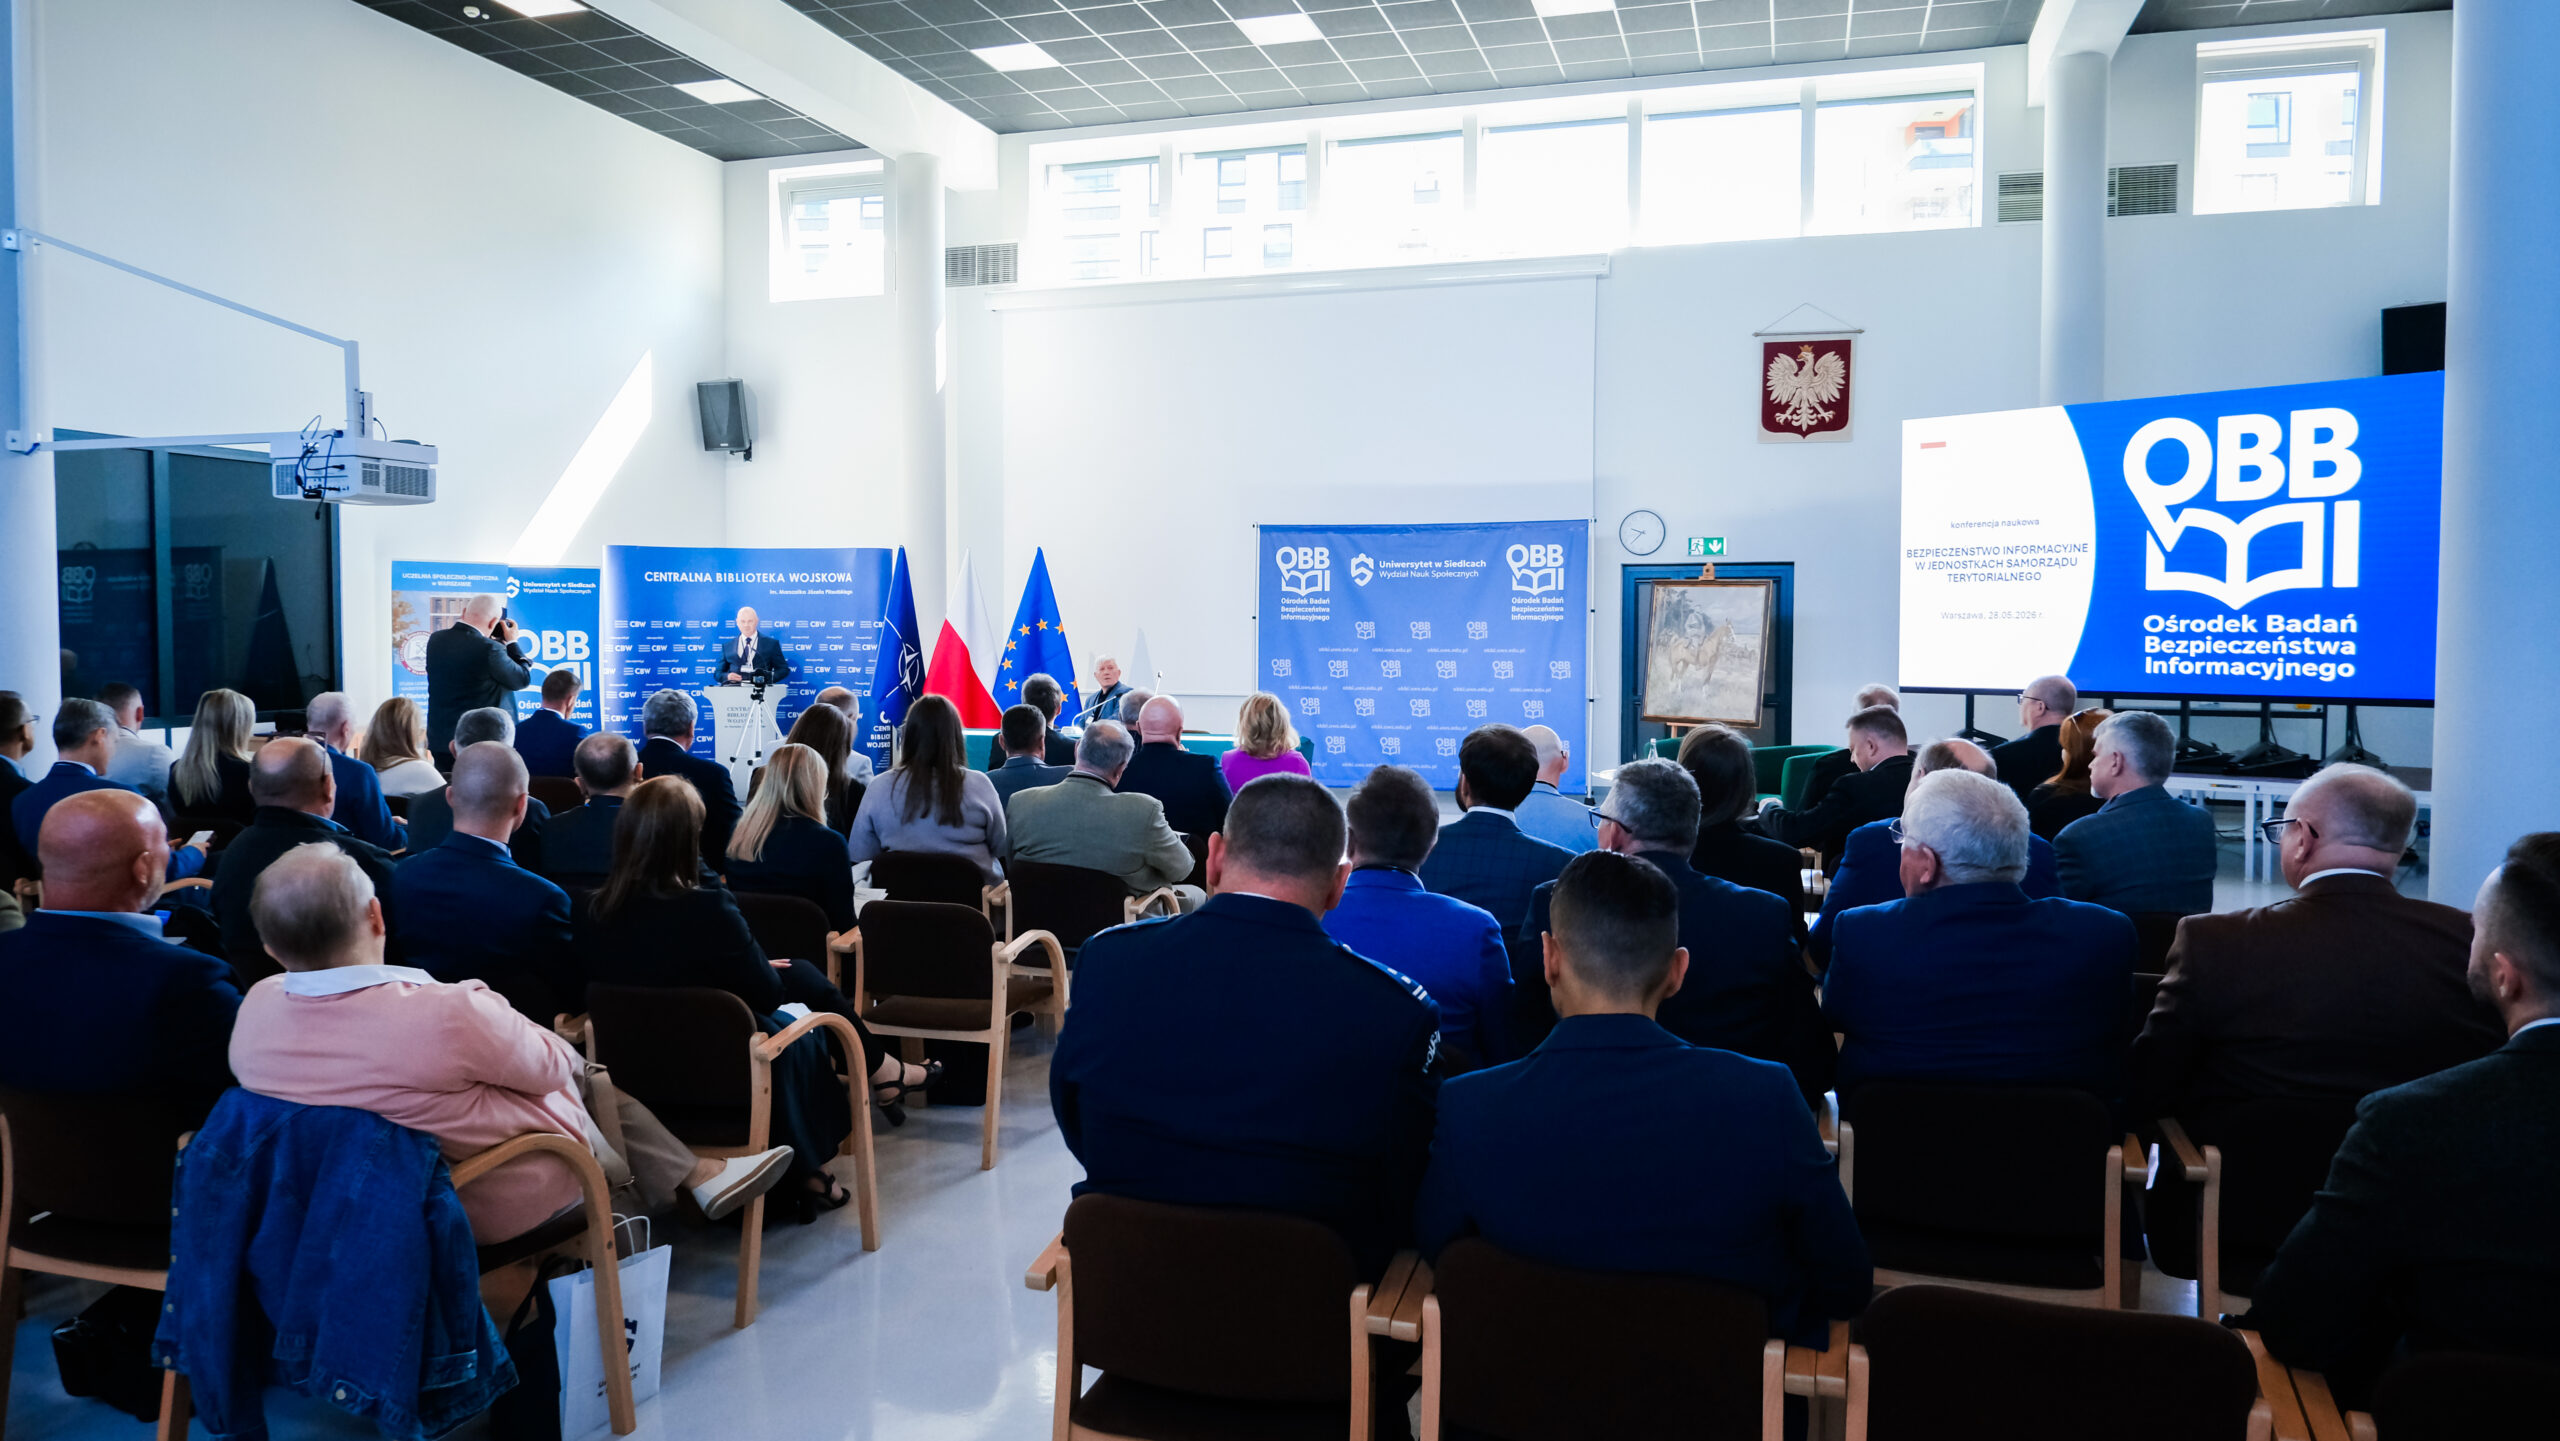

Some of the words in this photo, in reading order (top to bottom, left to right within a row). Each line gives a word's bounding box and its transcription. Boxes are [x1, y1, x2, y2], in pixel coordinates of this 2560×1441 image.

[1950, 519, 2000, 529] konferencja
[2002, 518, 2040, 526] naukowa
[1906, 545, 2000, 558] BEZPIECZEŃSTWO
[2003, 543, 2088, 555] INFORMACYJNE
[1379, 560, 1432, 569] Uniwersytet
[1915, 562, 1926, 570] W
[1928, 559, 2004, 570] JEDNOSTKACH
[2006, 557, 2078, 569] SAMORZĄDU
[644, 571, 712, 582] CENTRALNA
[716, 572, 786, 583] BIBLIOTEKA
[789, 572, 853, 583] WOJSKOWA
[1379, 570, 1409, 579] Wydział
[1431, 570, 1479, 579] Społecznych
[1947, 571, 2042, 582] TERYTORIALNEGO
[1511, 605, 1564, 613] Bezpieczeństwa
[1281, 613, 1330, 622] Informacyjnego
[1511, 614, 1564, 622] Informacyjnego
[2143, 614, 2258, 633] Ośrodek
[2266, 613, 2358, 633] Badań
[2144, 635, 2356, 657] Bezpieczeństwa
[2144, 656, 2356, 682] Informacyjnego
[518, 700, 542, 709] Ośro
[575, 699, 592, 708] dań
